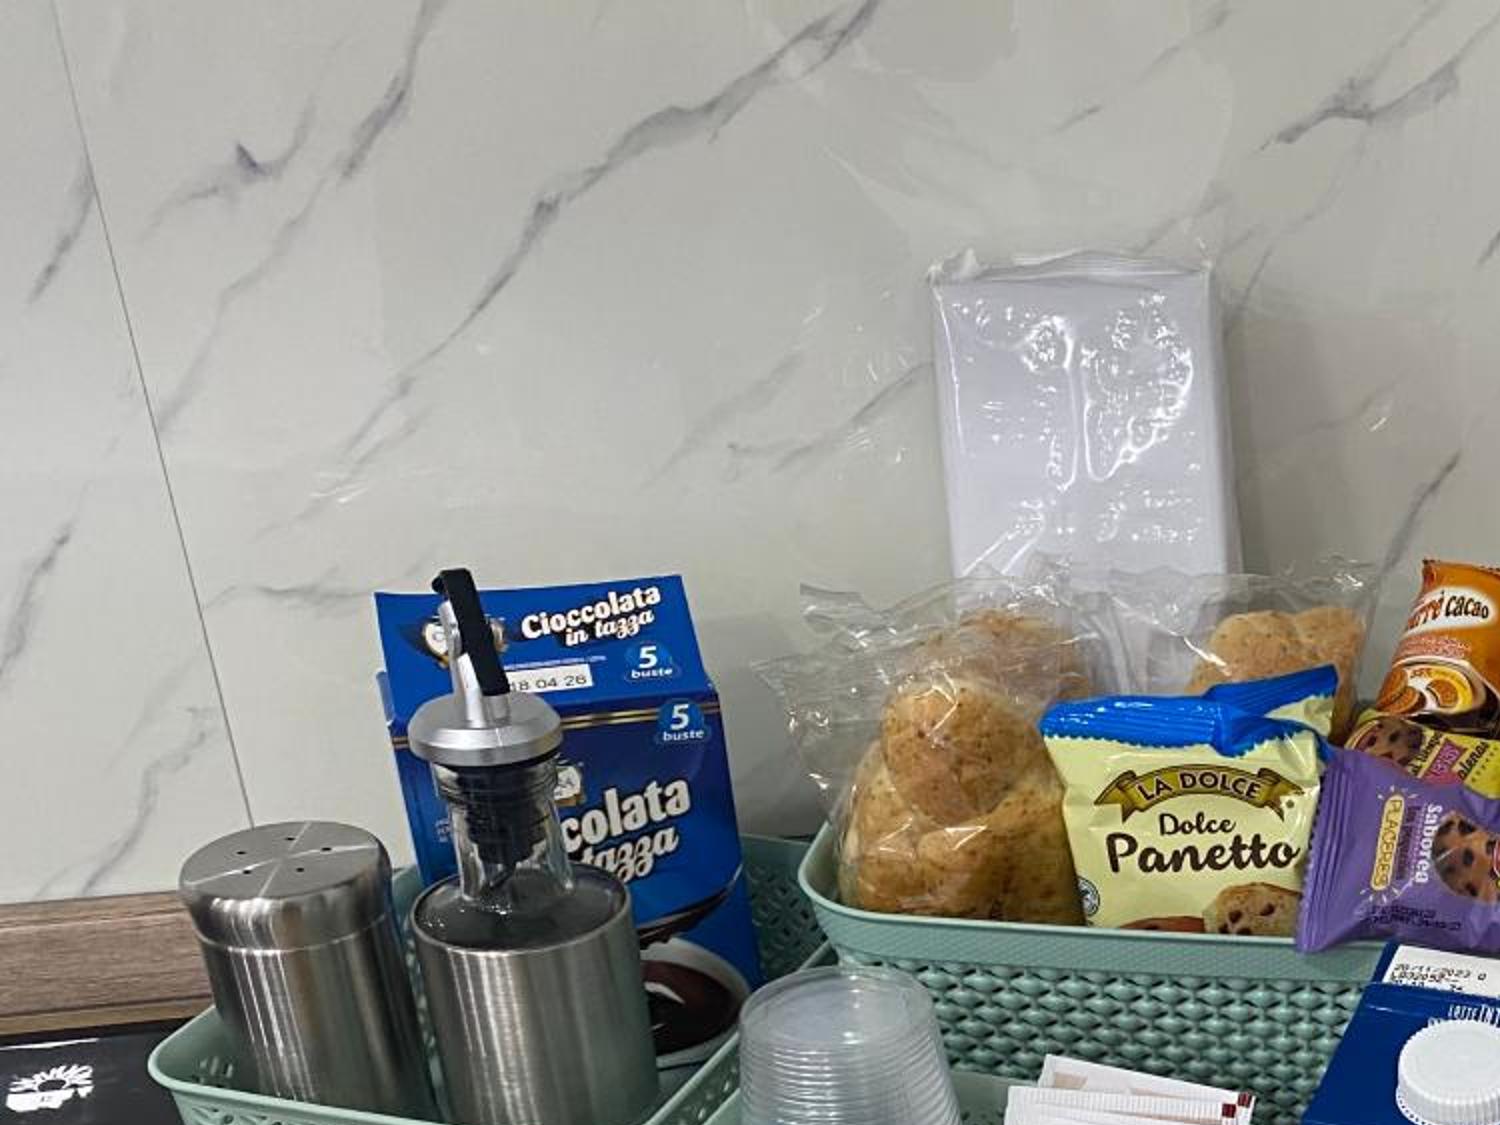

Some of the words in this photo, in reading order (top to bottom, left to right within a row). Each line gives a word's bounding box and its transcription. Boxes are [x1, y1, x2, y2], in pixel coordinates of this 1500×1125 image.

[522, 585, 661, 640] Cioccolata
[565, 627, 589, 647] in
[595, 610, 656, 640] tazza
[638, 646, 657, 669] 5
[630, 666, 673, 680] buste
[670, 702, 691, 730] 5
[663, 728, 704, 742] buste
[1137, 776, 1173, 801] LA
[1179, 770, 1262, 800] DOLCE
[561, 779, 691, 853] colata
[1158, 811, 1237, 837] Dolce
[1105, 831, 1302, 874] Panetto
